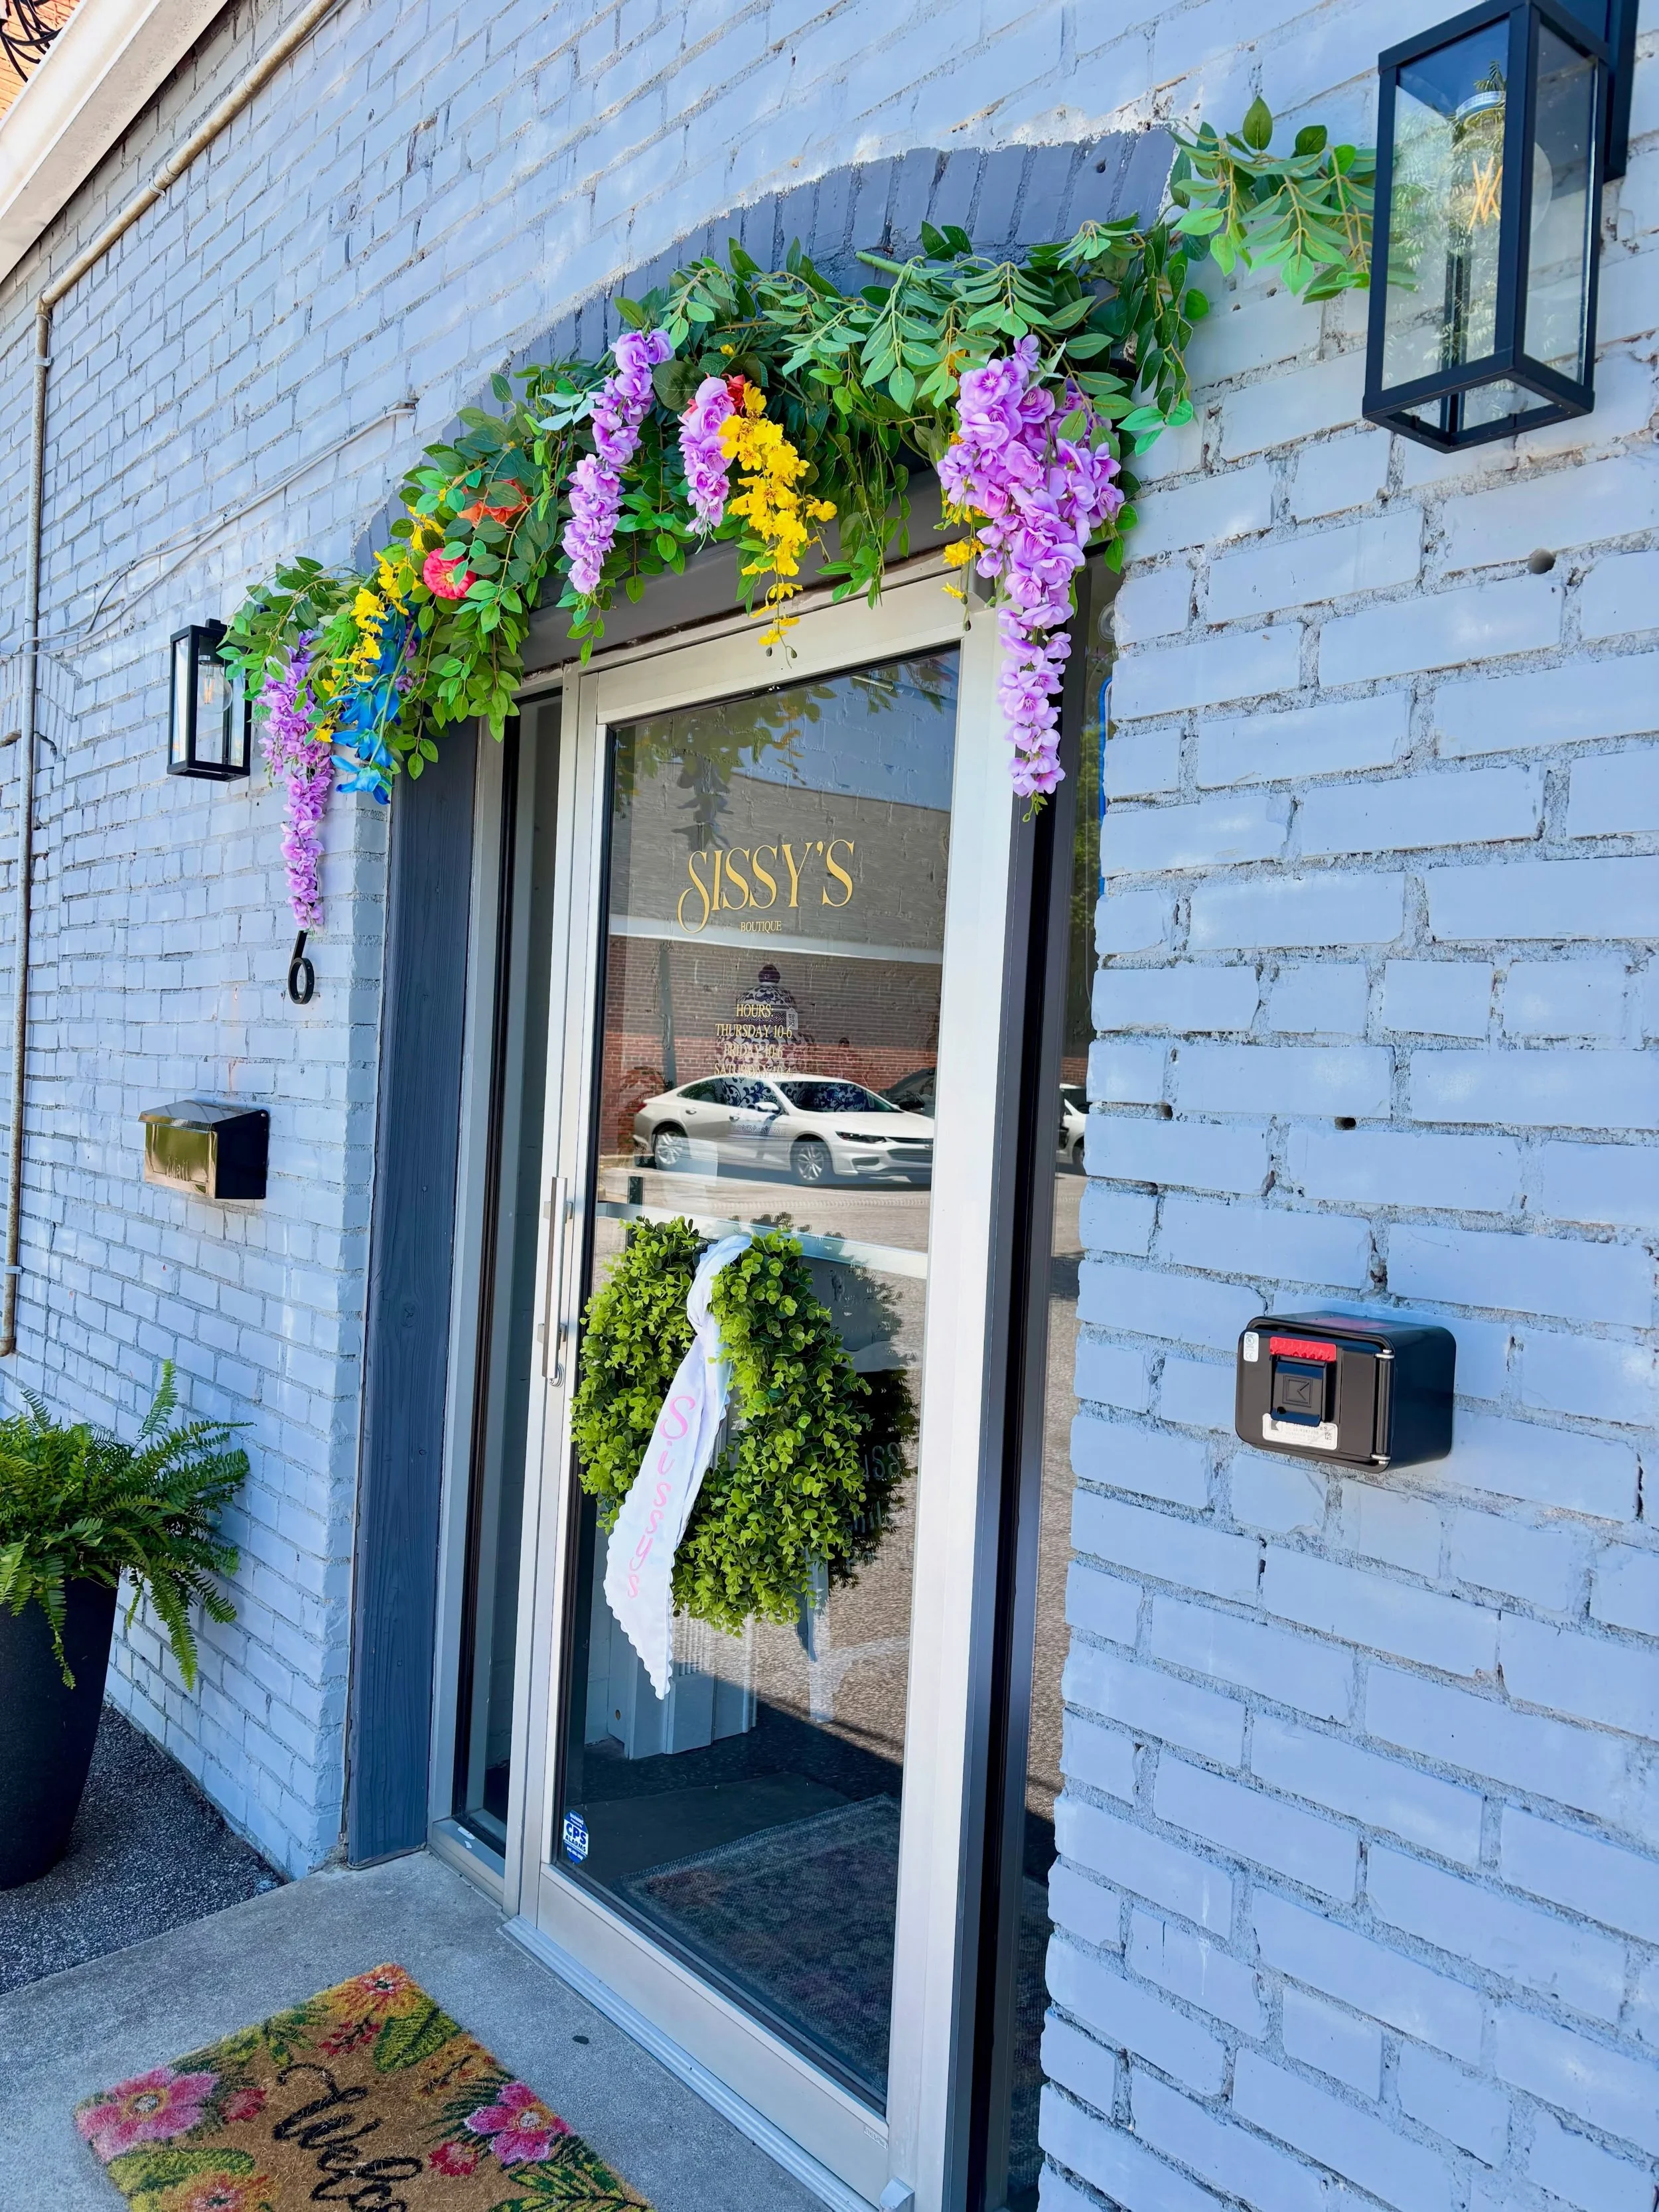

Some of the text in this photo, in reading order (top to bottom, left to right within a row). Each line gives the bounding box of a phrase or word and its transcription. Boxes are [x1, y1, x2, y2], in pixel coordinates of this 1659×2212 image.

[677, 839, 855, 934] SISSY'S
[740, 921, 782, 933] BOUTIQUE
[736, 1003, 774, 1017] HOURS:
[715, 1023, 793, 1039] THURSDAY 10-6
[723, 1043, 783, 1058] FRIDAY 10-6
[714, 1063, 793, 1079] SATURDAY 10-4
[166, 1154, 190, 1181] Mail
[566, 1822, 587, 1845] CPS
[565, 1834, 586, 1852] ALARMS
